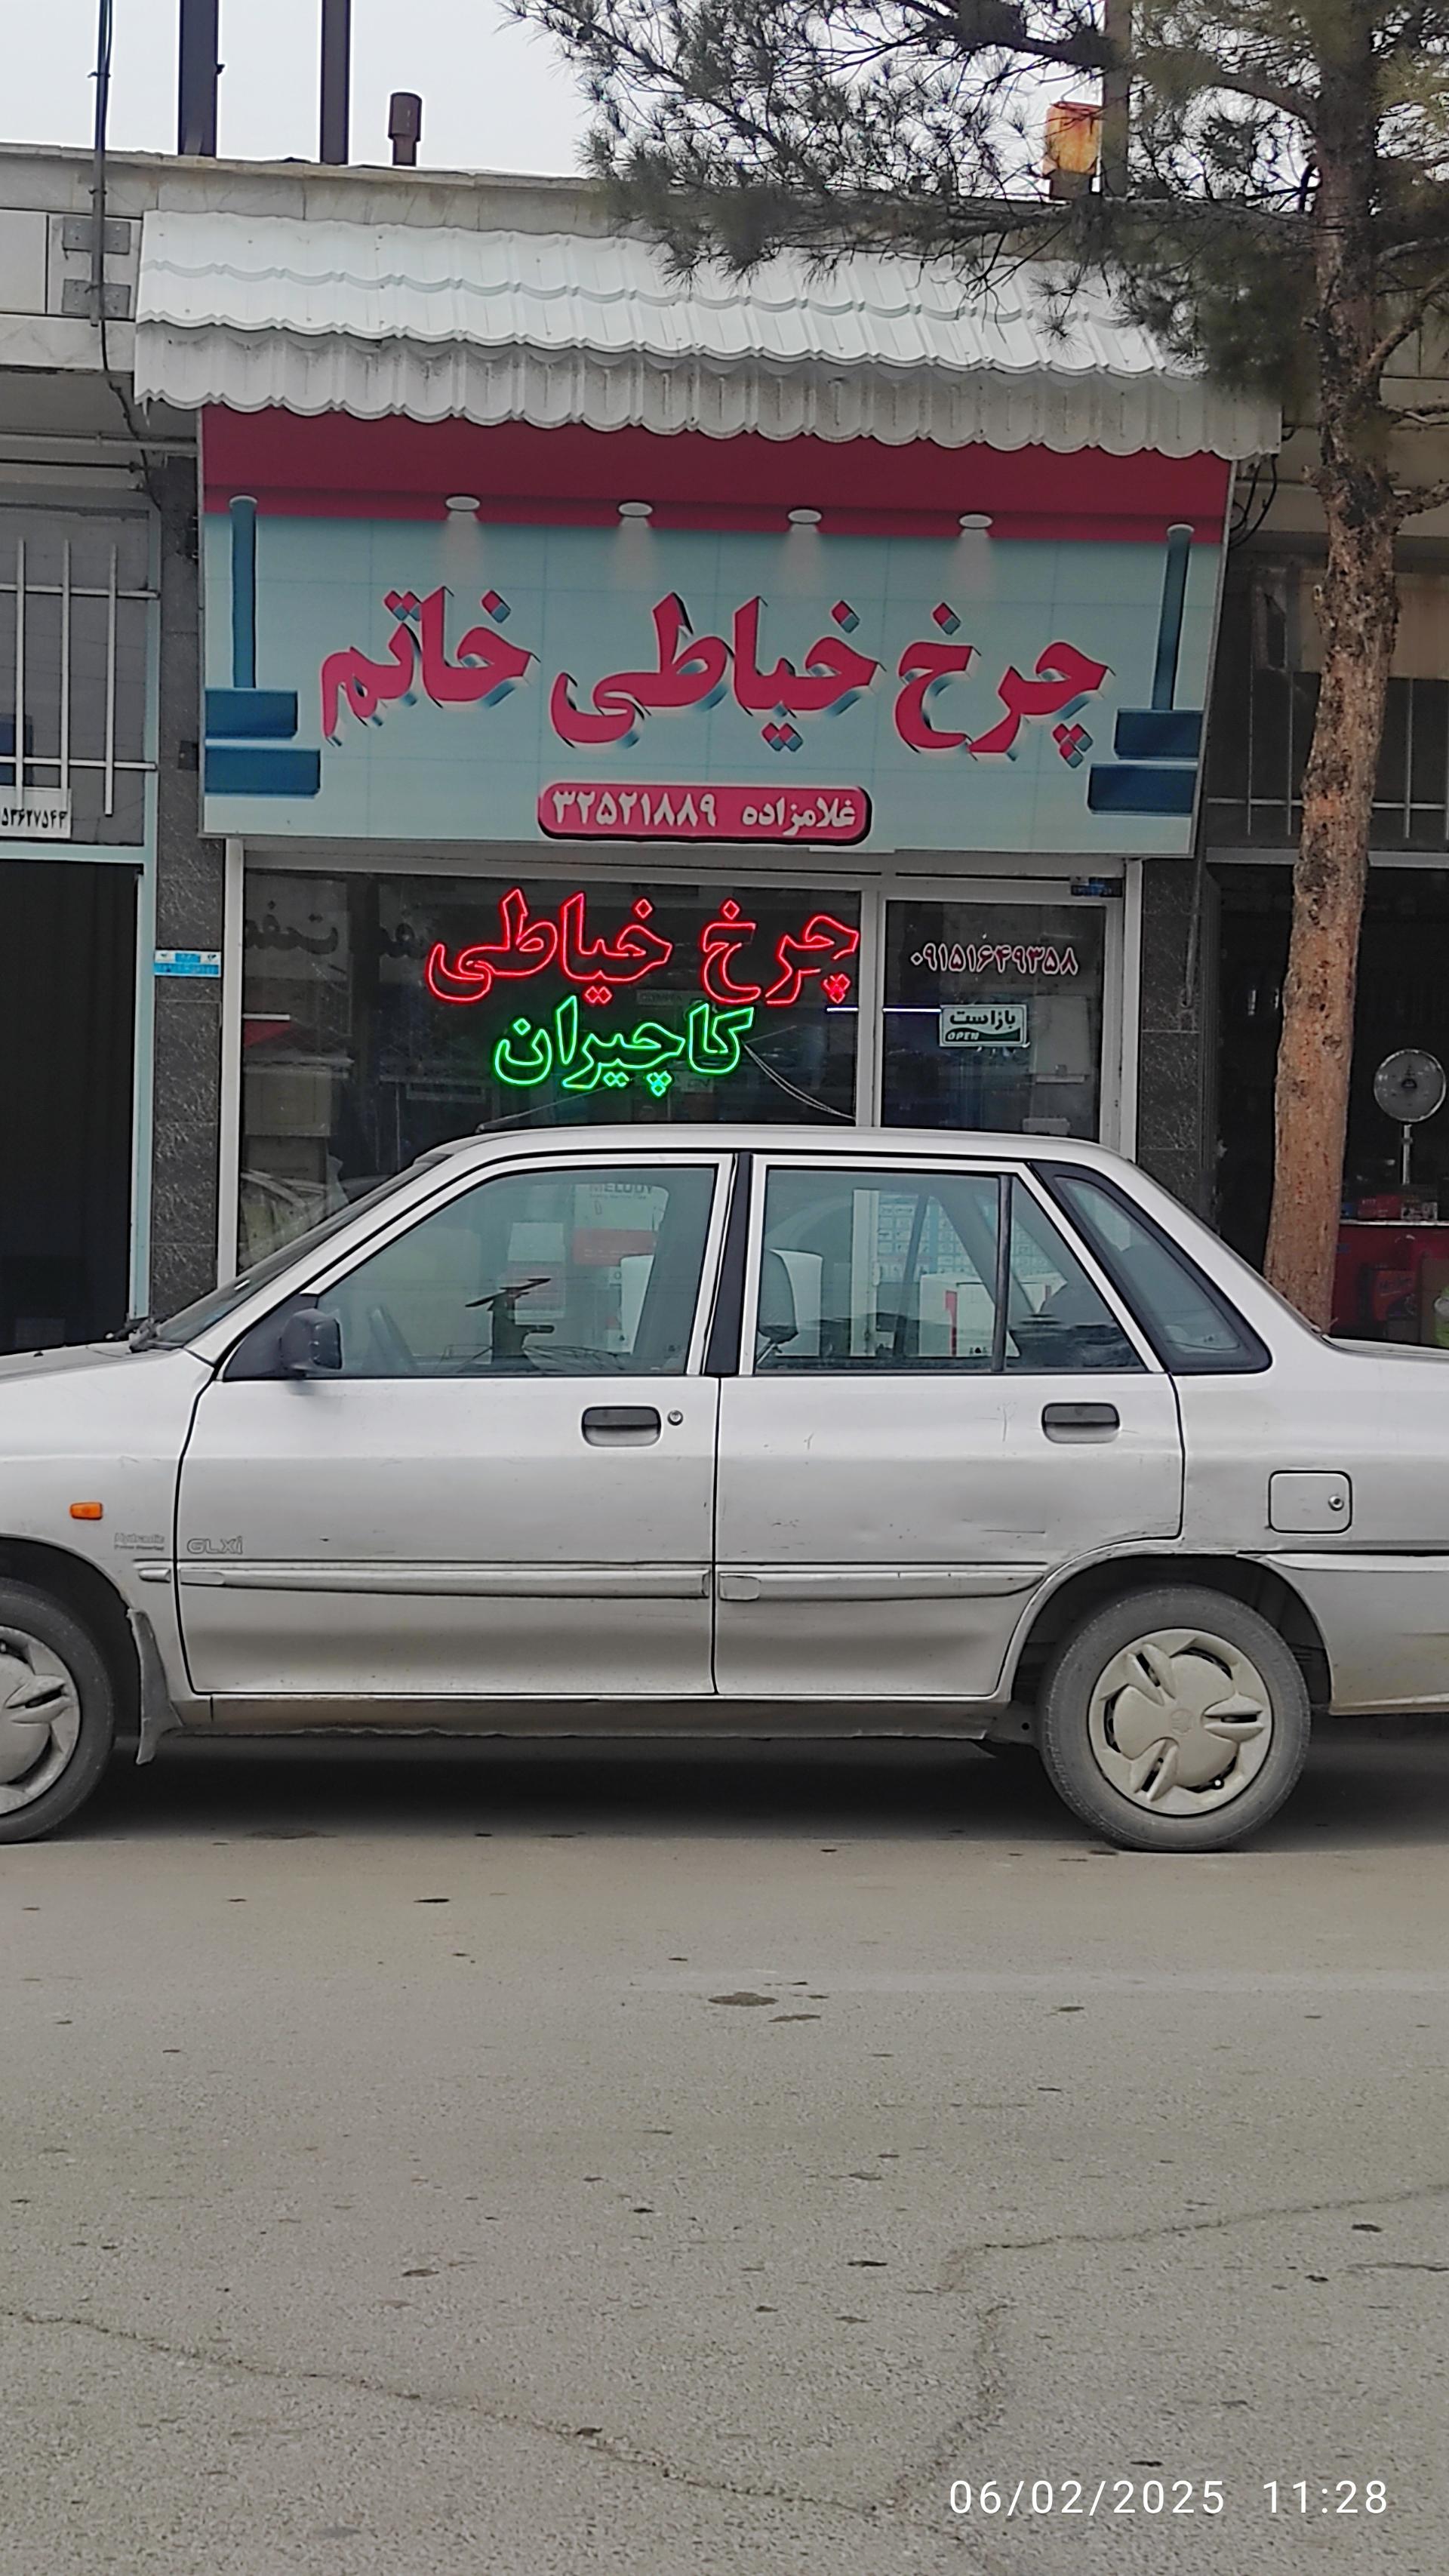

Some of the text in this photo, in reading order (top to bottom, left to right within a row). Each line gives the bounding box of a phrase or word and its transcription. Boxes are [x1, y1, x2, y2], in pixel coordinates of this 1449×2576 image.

[320, 587, 1108, 761] چرخ خیاطی خاتم
[552, 791, 855, 836] غلامزاده ۳۲۵۲۱۸۸۹
[426, 887, 674, 1005] خیاطی
[700, 899, 860, 1006] چرخ
[910, 943, 1078, 975] ۰۹۱۵۱۶۴۹۳۵۸
[493, 993, 755, 1097] کاچیران
[947, 1032, 980, 1041] OPEN
[187, 1535, 243, 1555] GLXi
